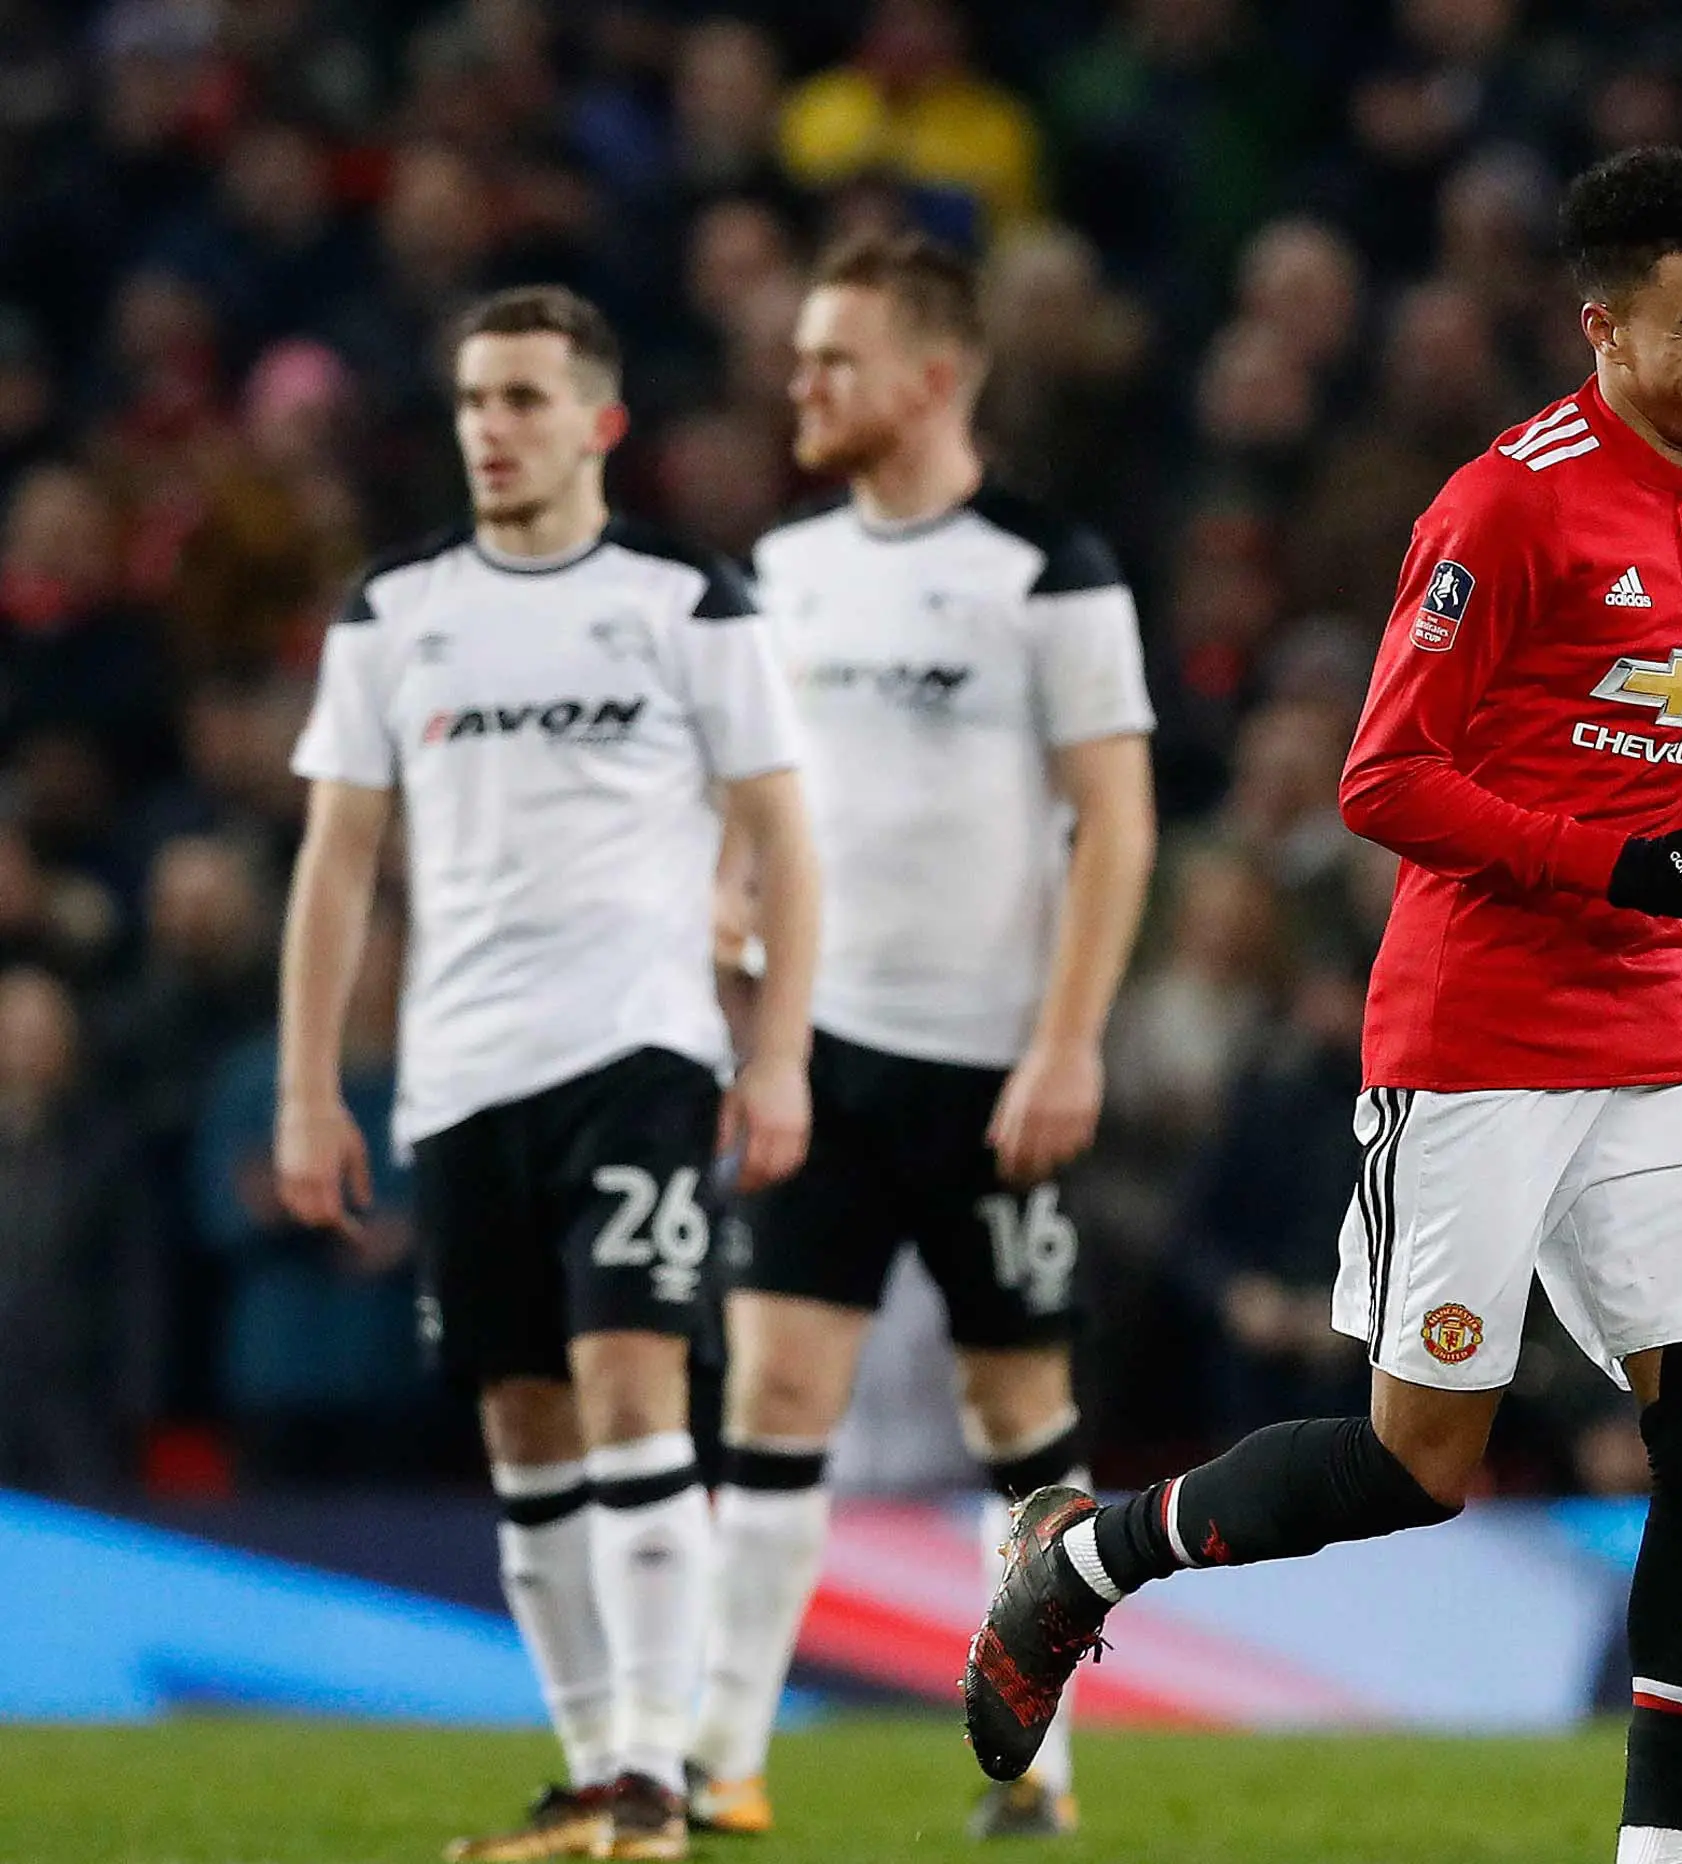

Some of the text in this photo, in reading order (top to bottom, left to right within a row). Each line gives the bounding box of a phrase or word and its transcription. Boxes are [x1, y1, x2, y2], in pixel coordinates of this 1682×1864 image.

[1605, 592, 1652, 608] adidas
[592, 1163, 710, 1268] 26
[973, 1180, 1078, 1290] 16
